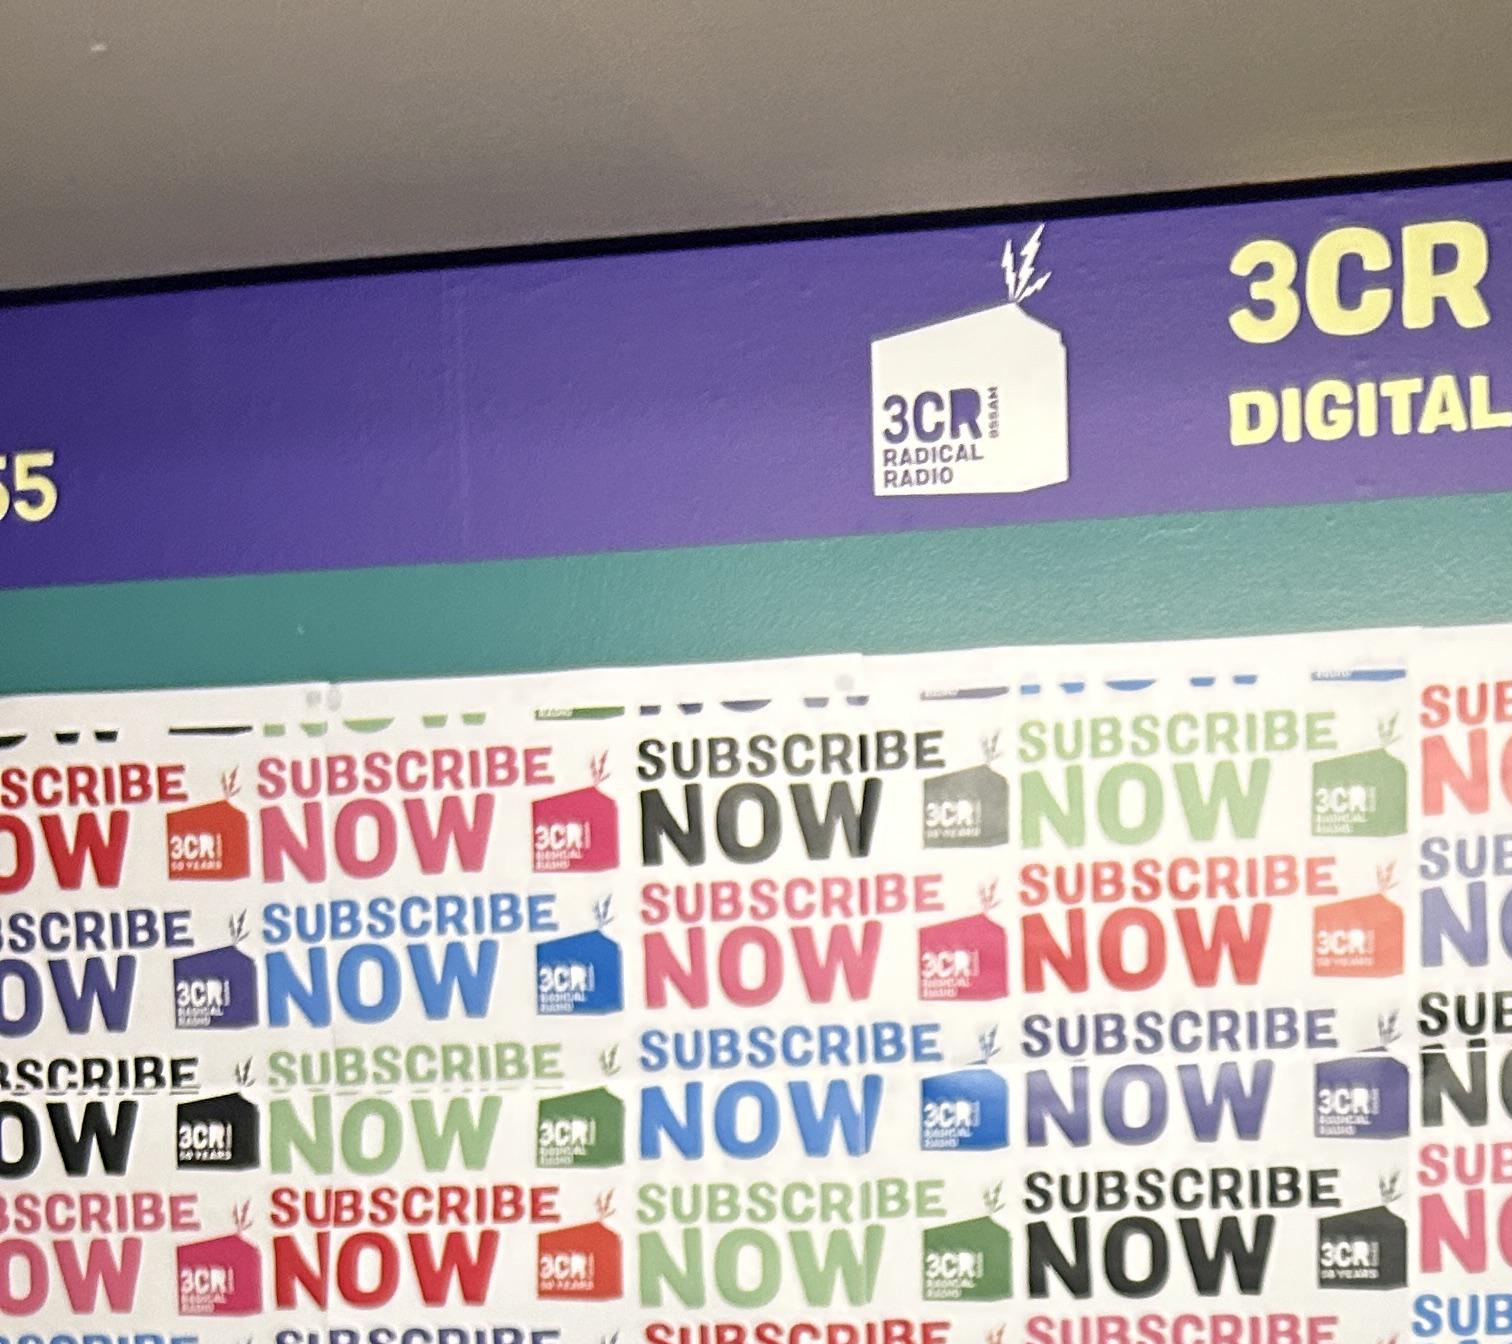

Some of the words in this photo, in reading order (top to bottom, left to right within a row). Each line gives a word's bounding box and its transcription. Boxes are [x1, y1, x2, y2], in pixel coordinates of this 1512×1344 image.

[1228, 219, 1492, 344] 3CR
[883, 388, 983, 444] 3CR
[0, 450, 57, 522] 5
[883, 444, 984, 467] RADICAL
[883, 466, 954, 488] RADIO
[637, 730, 945, 782] SUBSCRIBE
[1018, 709, 1338, 763] SUBSCRIBE
[257, 746, 554, 800] SUBSCRIBE
[1020, 757, 1271, 849] NOW
[259, 793, 494, 883] NOW
[639, 777, 882, 866] NOW
[640, 873, 944, 925] SUBSCRIBE
[1019, 855, 1338, 907] SUBSCRIBE
[262, 893, 558, 945] SUBSCRIBE
[1021, 903, 1271, 993] NOW
[265, 939, 498, 1028] NOW
[642, 920, 882, 1009] NOW
[639, 1022, 943, 1072] SUBSCRIBE
[1021, 1007, 1338, 1058] SUBSCRIBE
[269, 1094, 502, 1176] NOW
[639, 1074, 883, 1160] NOW
[1025, 1060, 1273, 1147] NOW
[270, 1184, 560, 1228] SUBSCRIBE
[636, 1178, 947, 1225] SUBSCRIBE
[1023, 1167, 1341, 1214] SUBSCRIBE
[272, 1229, 499, 1311] NOW
[637, 1224, 885, 1310] NOW
[1026, 1214, 1275, 1299] NOW
